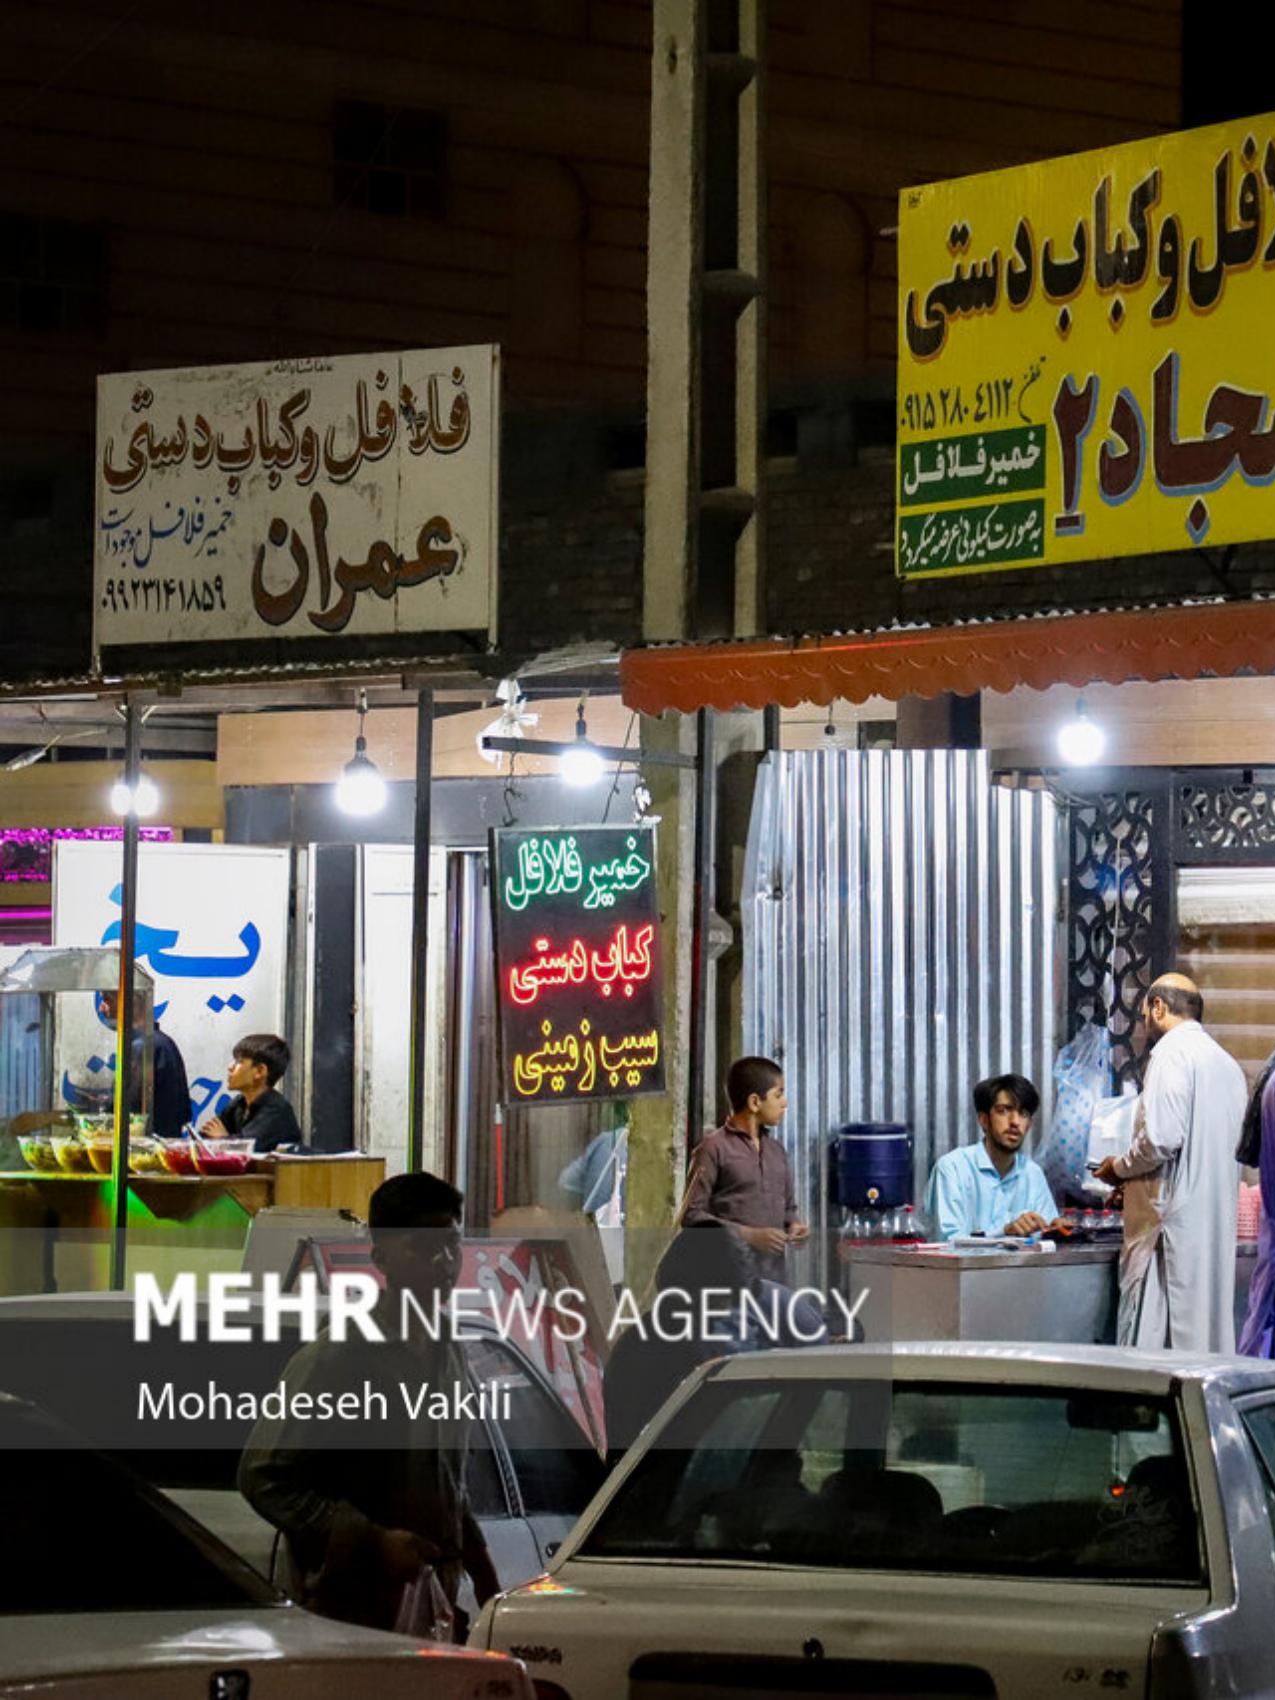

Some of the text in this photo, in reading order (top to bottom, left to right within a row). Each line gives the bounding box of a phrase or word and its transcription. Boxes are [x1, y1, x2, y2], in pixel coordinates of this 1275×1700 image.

[905, 215, 1034, 362] دستی
[1041, 167, 1162, 341] کباب
[1151, 213, 1181, 323] و
[103, 387, 215, 492] دستی
[212, 388, 311, 494] کباب
[296, 422, 319, 485] و
[904, 430, 1041, 495] خمیر فلافل
[1053, 372, 1100, 516] ۲
[133, 496, 205, 568] فلافل
[194, 496, 234, 559] خمیر
[251, 491, 458, 633] عمران
[505, 836, 651, 911] خمیر فلافل
[509, 924, 654, 1005] کباب دستی
[513, 1018, 659, 1096] سیب زمینی
